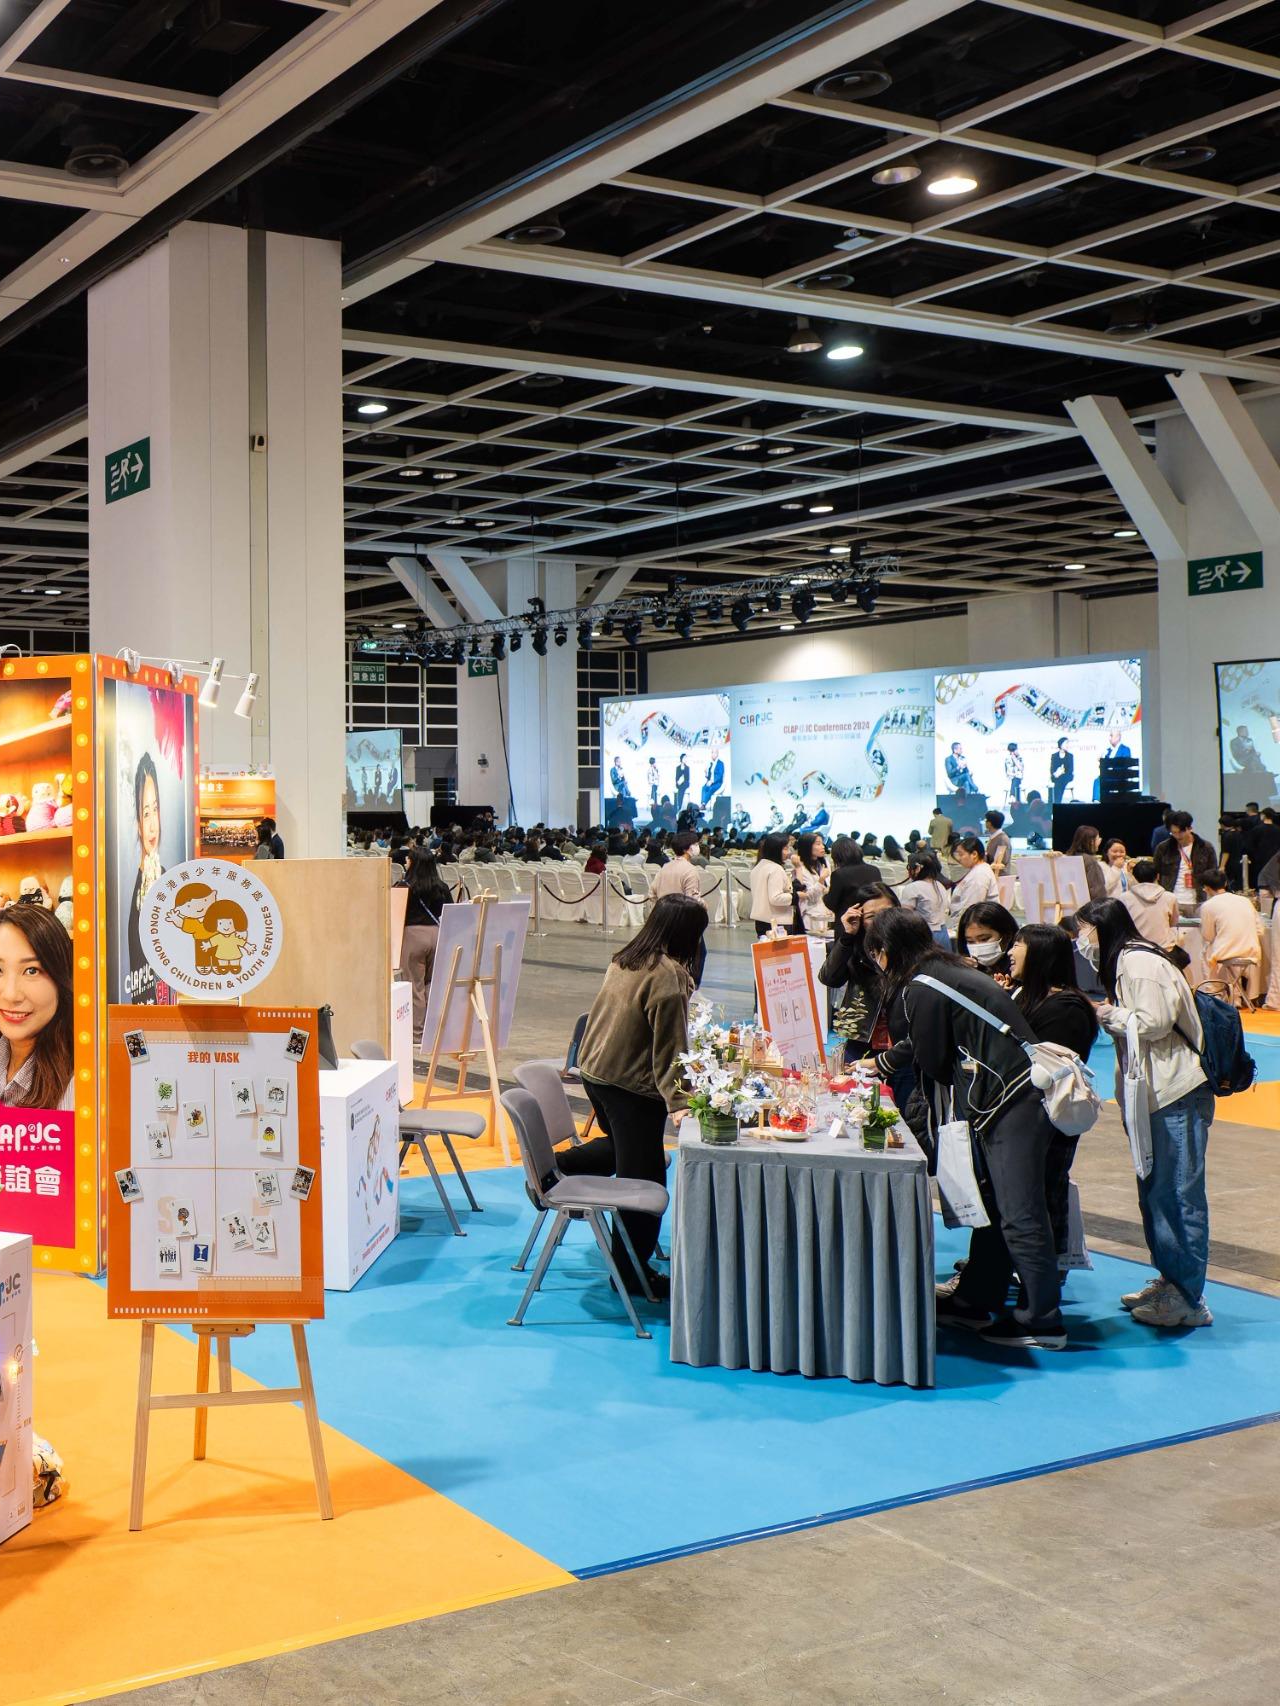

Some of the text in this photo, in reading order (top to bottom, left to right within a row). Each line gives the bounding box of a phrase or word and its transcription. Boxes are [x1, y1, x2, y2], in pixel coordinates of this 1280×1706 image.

[814, 722, 852, 732] Conference
[853, 720, 870, 730] 2024
[150, 906, 161, 934] HONG
[261, 905, 274, 958] SERVICES
[152, 938, 170, 966] KONG
[170, 966, 222, 990] CHILDREN
[236, 958, 264, 984] YOUTH
[226, 980, 235, 988] &
[187, 1051, 240, 1064] 我的 VASK
